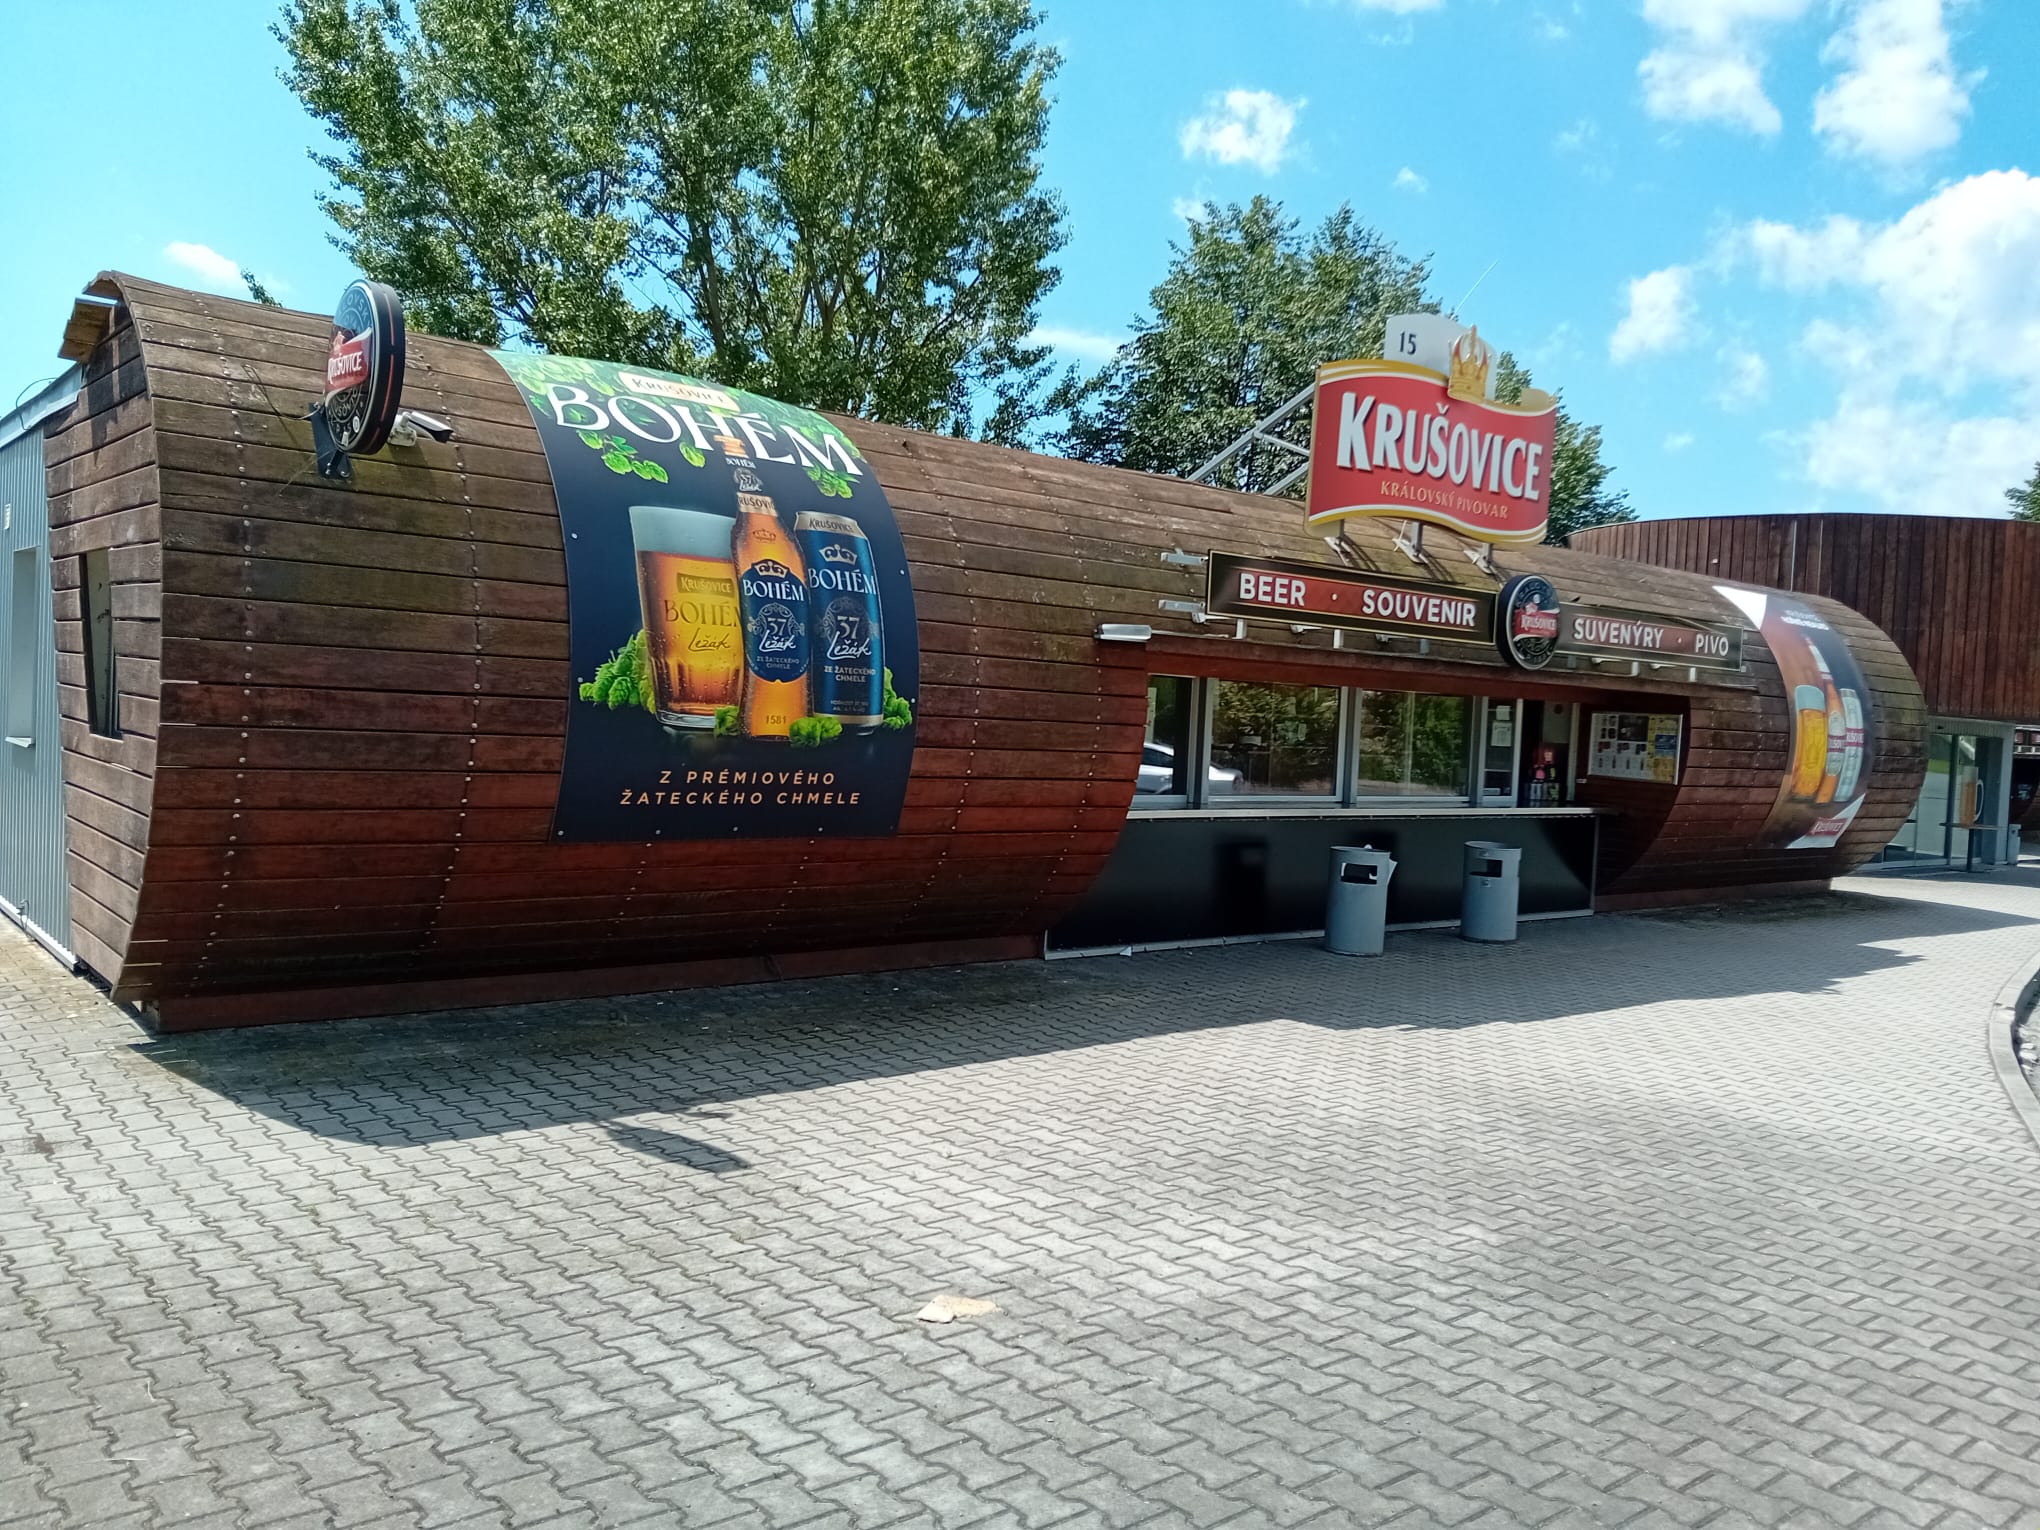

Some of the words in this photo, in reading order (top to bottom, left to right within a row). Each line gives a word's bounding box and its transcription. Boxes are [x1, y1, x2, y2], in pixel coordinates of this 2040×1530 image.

[1399, 331, 1417, 355] 15
[547, 383, 863, 476] BOHÉM
[1336, 391, 1543, 501] KRUŠOVICE
[1381, 480, 1455, 507] KRÁLOVSKÝ
[1457, 495, 1509, 519] PIVOVAR
[680, 576, 732, 593] KRUŠOVICE
[743, 579, 805, 601] BOHÉM
[808, 568, 876, 595] BOHÉM
[1239, 572, 1306, 607] BEER
[1362, 589, 1476, 627] SOUVENIR
[767, 617, 787, 636] 37
[837, 615, 860, 640] 37
[1574, 619, 1664, 649] SUVENÝRY
[1695, 633, 1729, 657] PIVO
[688, 628, 730, 652] Ležák
[759, 629, 797, 652] Ležák
[827, 630, 872, 660] Ležák
[766, 714, 787, 725] 1581
[659, 770, 672, 784] Z
[686, 768, 835, 785] PRÉMIOVÉHO
[620, 789, 763, 805] ŽATECKÉHO
[776, 792, 861, 805] CHMELE
